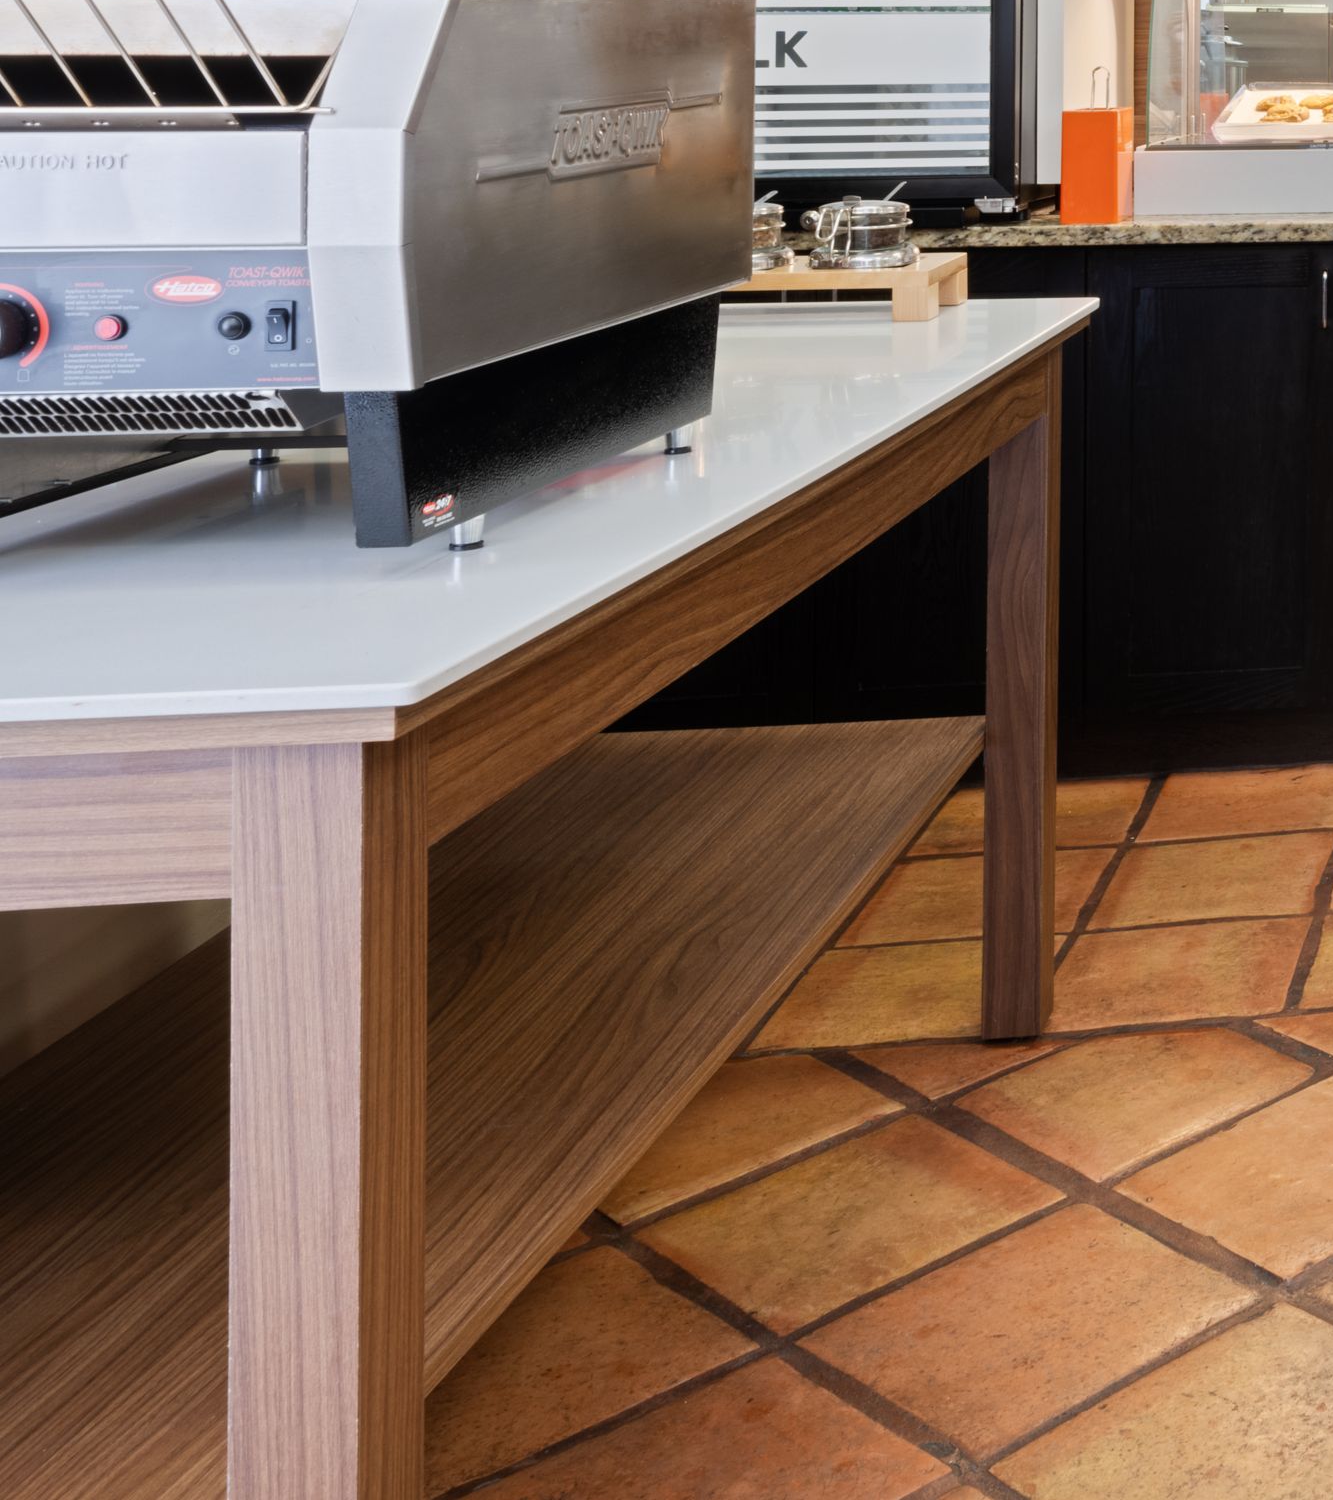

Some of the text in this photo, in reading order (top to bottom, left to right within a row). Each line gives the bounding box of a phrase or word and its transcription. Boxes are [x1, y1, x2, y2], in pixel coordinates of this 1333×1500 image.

[0, 153, 128, 170] AUTION HOT
[228, 266, 307, 278] TOAST-QWIK
[153, 281, 217, 296] Hatco
